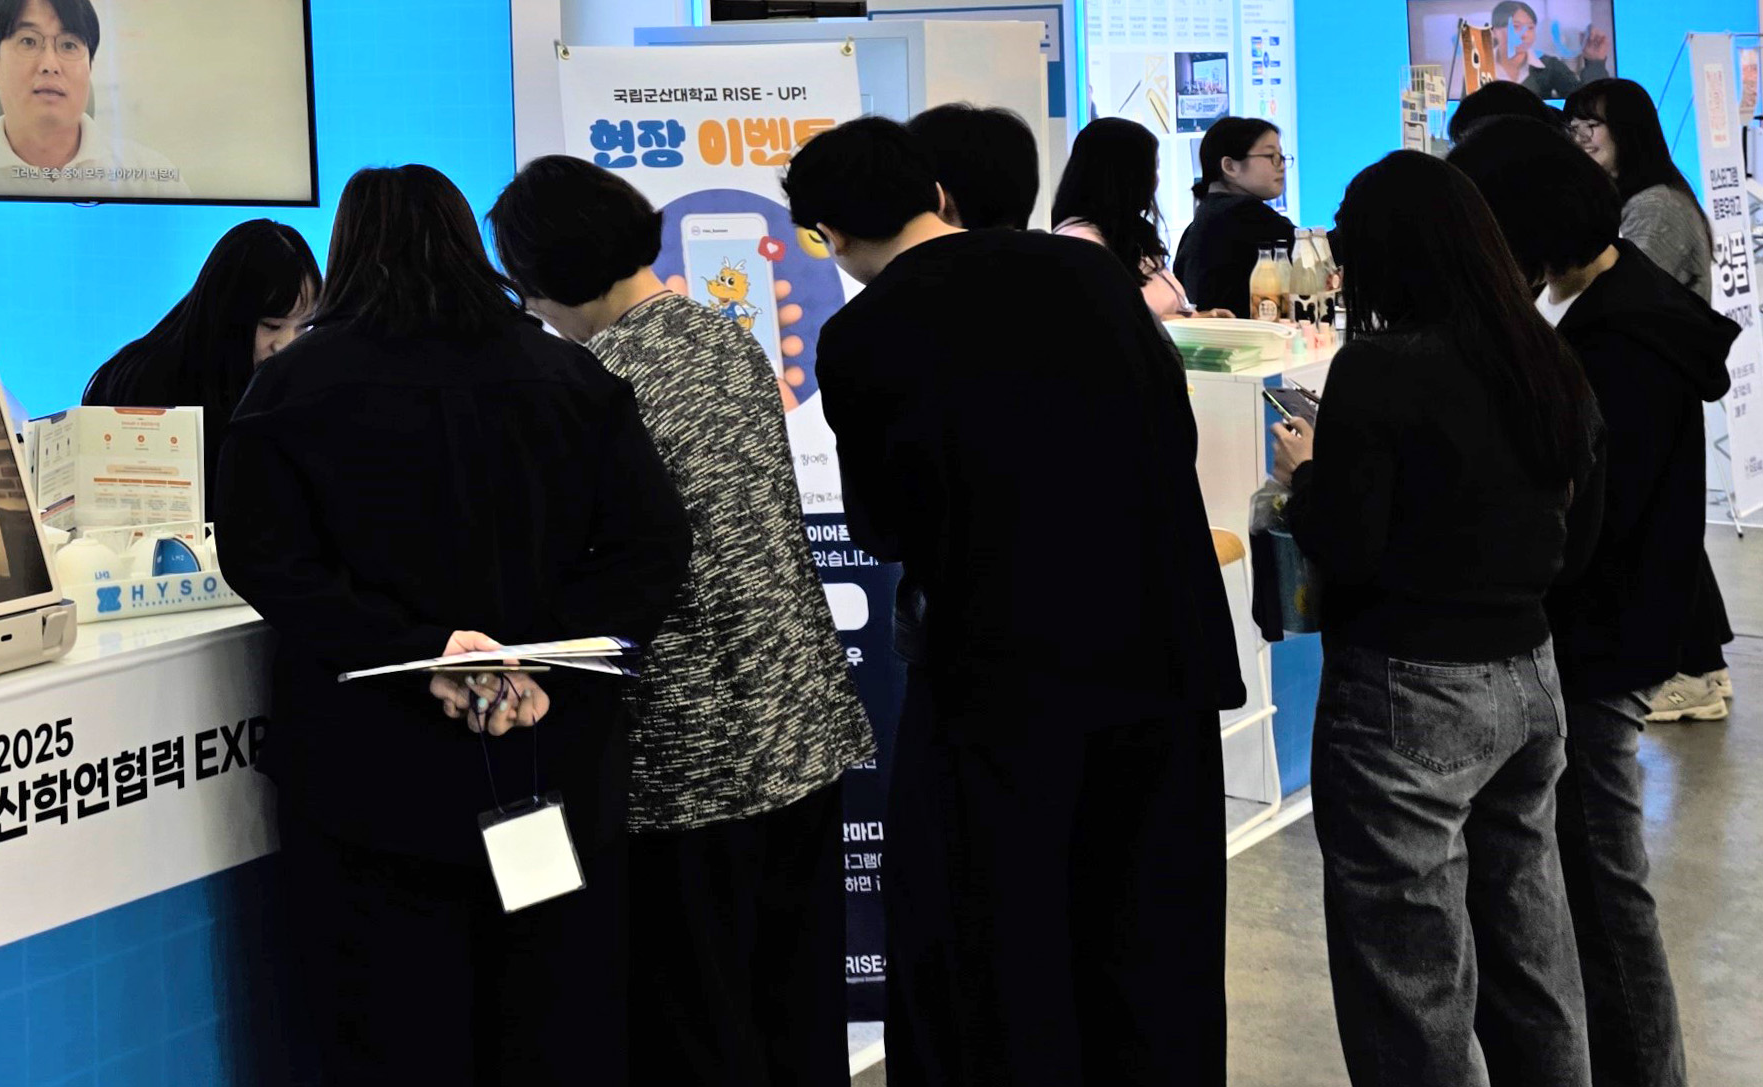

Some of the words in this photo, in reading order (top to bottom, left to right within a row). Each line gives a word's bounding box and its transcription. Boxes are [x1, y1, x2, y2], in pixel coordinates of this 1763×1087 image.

[613, 88, 718, 104] 국립군산대학교
[723, 88, 763, 102] RISE
[778, 86, 808, 101] UP!
[589, 119, 686, 169] 현장
[85, 167, 104, 179] 모두
[195, 715, 270, 782] EXP
